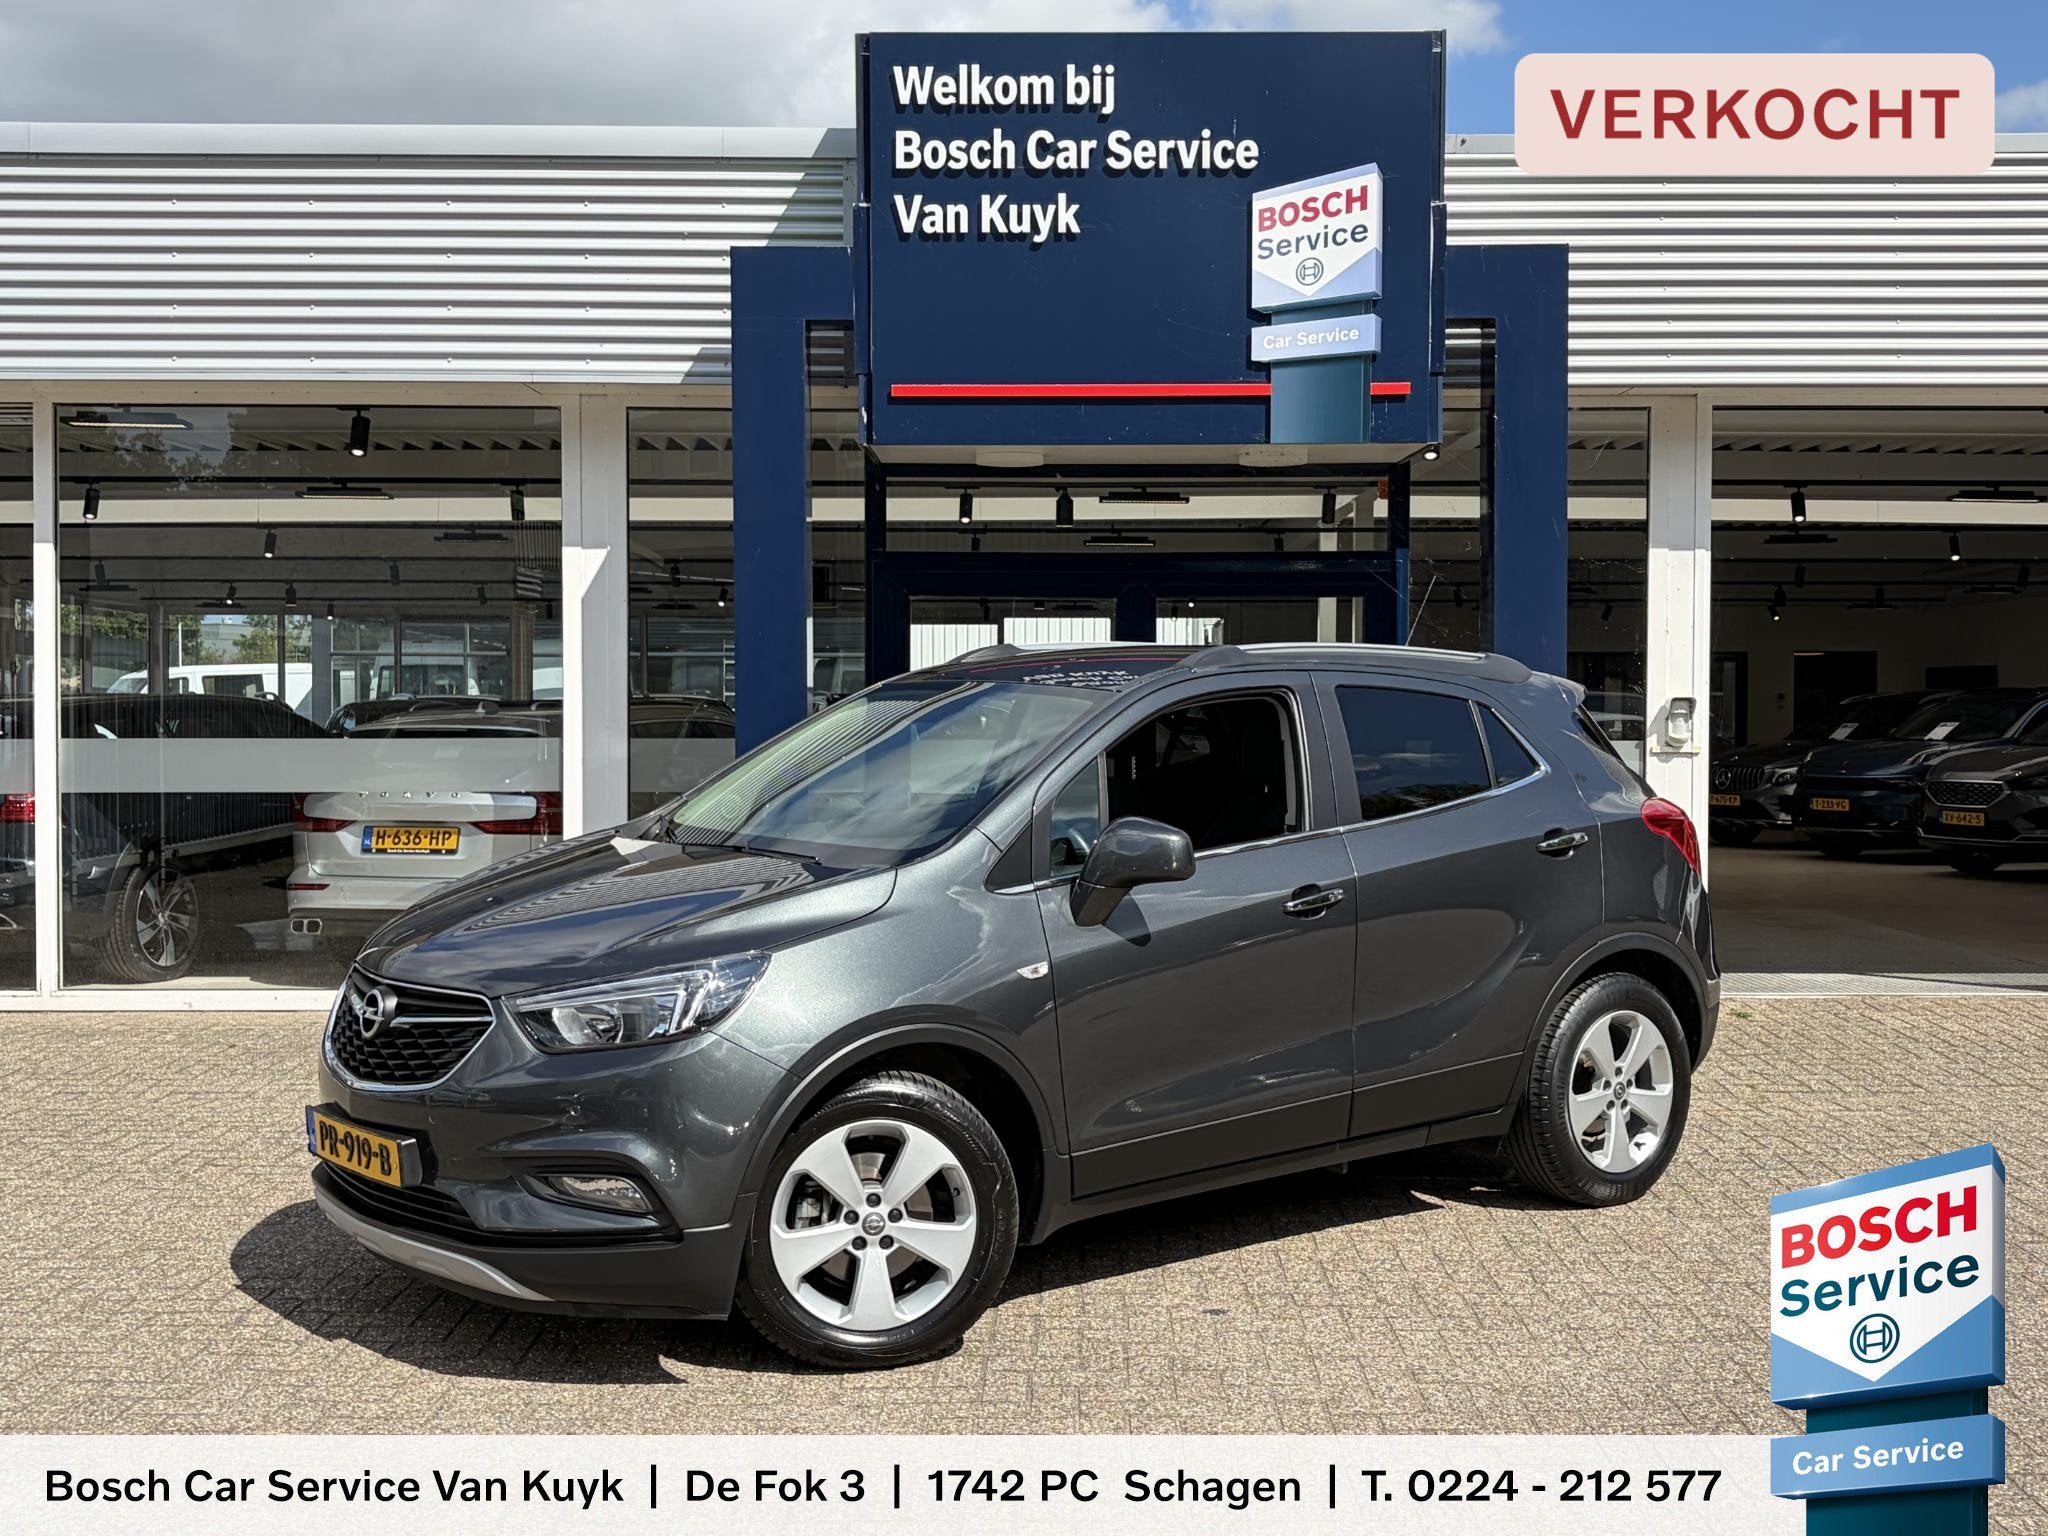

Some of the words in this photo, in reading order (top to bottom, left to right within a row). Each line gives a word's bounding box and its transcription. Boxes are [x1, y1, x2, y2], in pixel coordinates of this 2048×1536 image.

[893, 64, 1055, 106] Welkom
[1066, 64, 1115, 115] bij
[895, 128, 1016, 169] Bosch
[1026, 130, 1097, 170] Car
[1107, 129, 1259, 170] Service
[893, 194, 969, 234] Van
[981, 193, 1081, 243] Kuyk
[1258, 185, 1368, 232] BOSCH
[1257, 224, 1369, 260] Service
[1263, 335, 1292, 350] Car
[1297, 328, 1359, 346] Service
[375, 829, 452, 847] H-636-HP
[318, 1119, 392, 1176] PR-919-B
